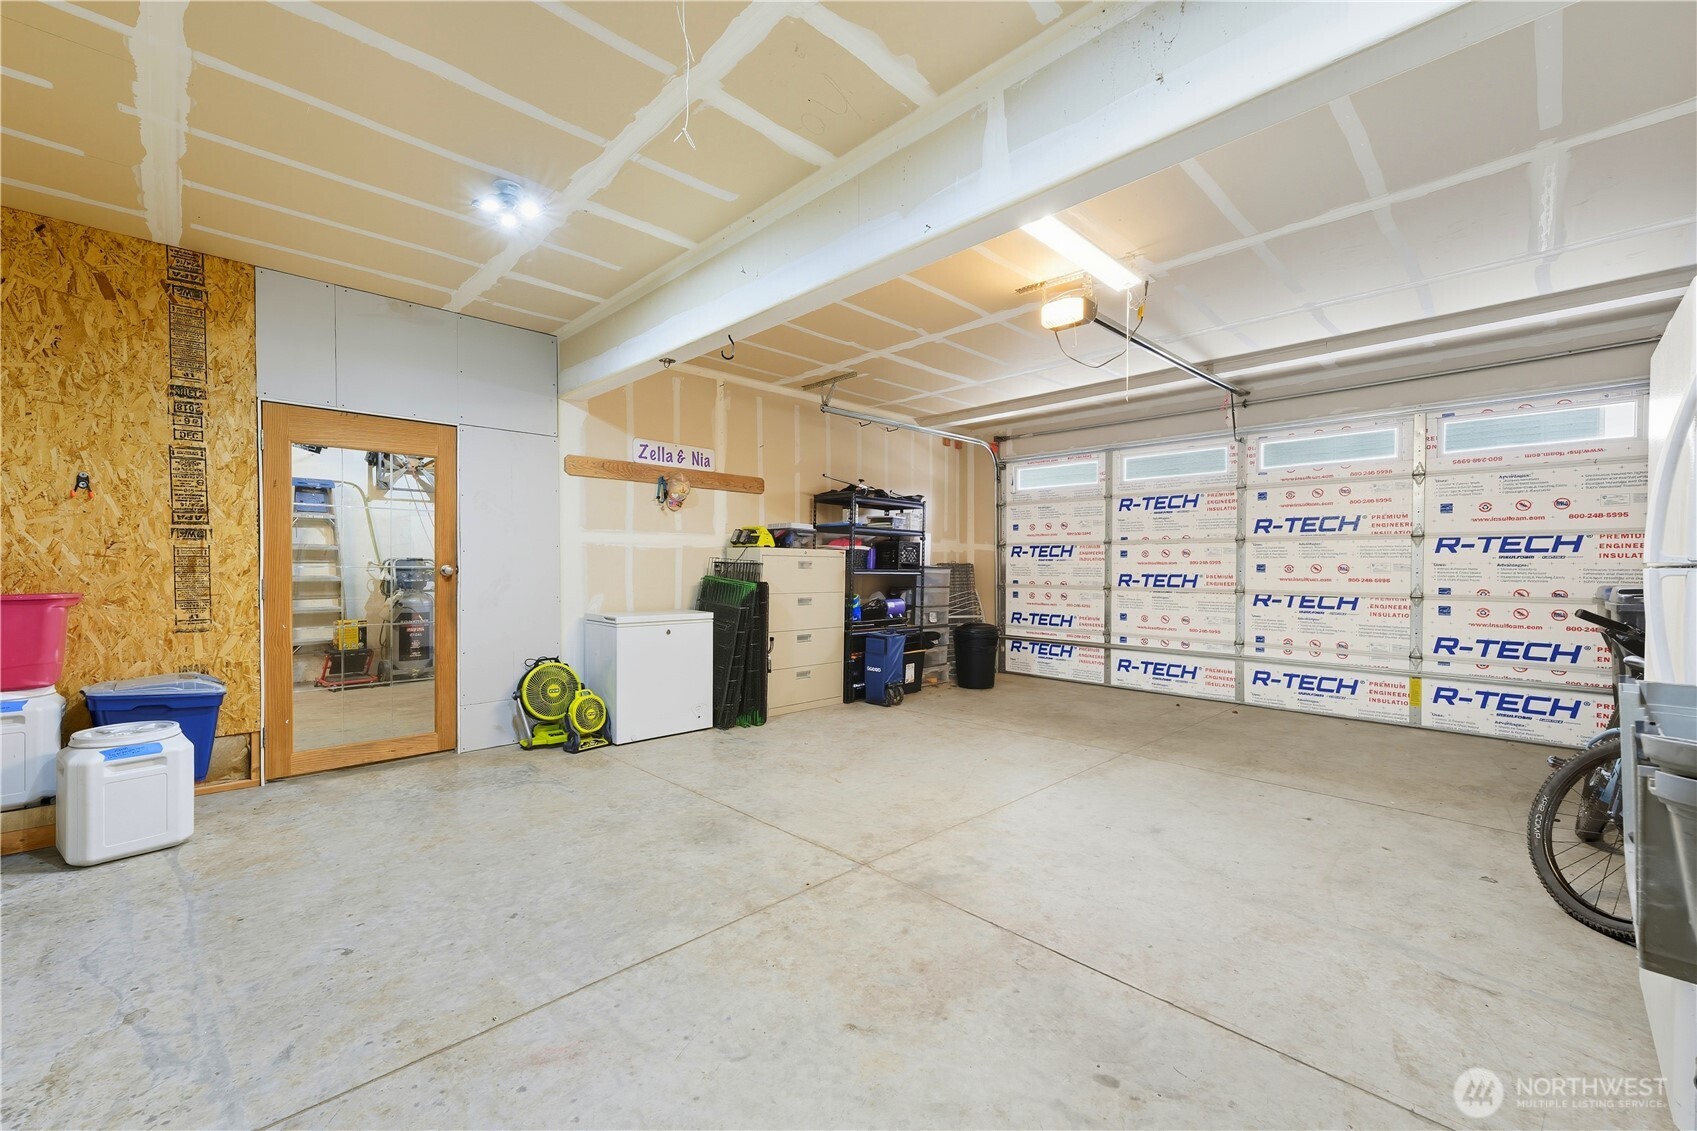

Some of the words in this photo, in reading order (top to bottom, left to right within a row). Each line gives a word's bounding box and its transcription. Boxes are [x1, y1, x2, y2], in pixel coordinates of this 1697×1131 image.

[638, 444, 673, 463] Zella
[677, 450, 686, 464] &
[692, 451, 711, 468] Nia
[1119, 494, 1200, 512] R-TECH
[1569, 511, 1629, 519] 800-248-5995
[1254, 515, 1362, 534] R-TECH
[1011, 545, 1074, 557] R-TECH
[1435, 535, 1584, 554] R-TECH
[1118, 574, 1198, 588] R-TECH
[1253, 594, 1359, 611] R-TECH
[1011, 612, 1073, 627] R-TECH
[1011, 640, 1073, 658] R-TECH
[1433, 637, 1582, 664] R-TECH
[1117, 659, 1198, 679] R-TECH
[1205, 681, 1235, 689] INSULATIO
[1252, 670, 1360, 695] R-TECH
[1369, 681, 1406, 689] PREMIUM
[1369, 689, 1411, 698] ENGINEER
[1369, 697, 1409, 706] INSULATIO
[1432, 687, 1582, 719] R-TECH
[1534, 813, 1543, 839] COMP
